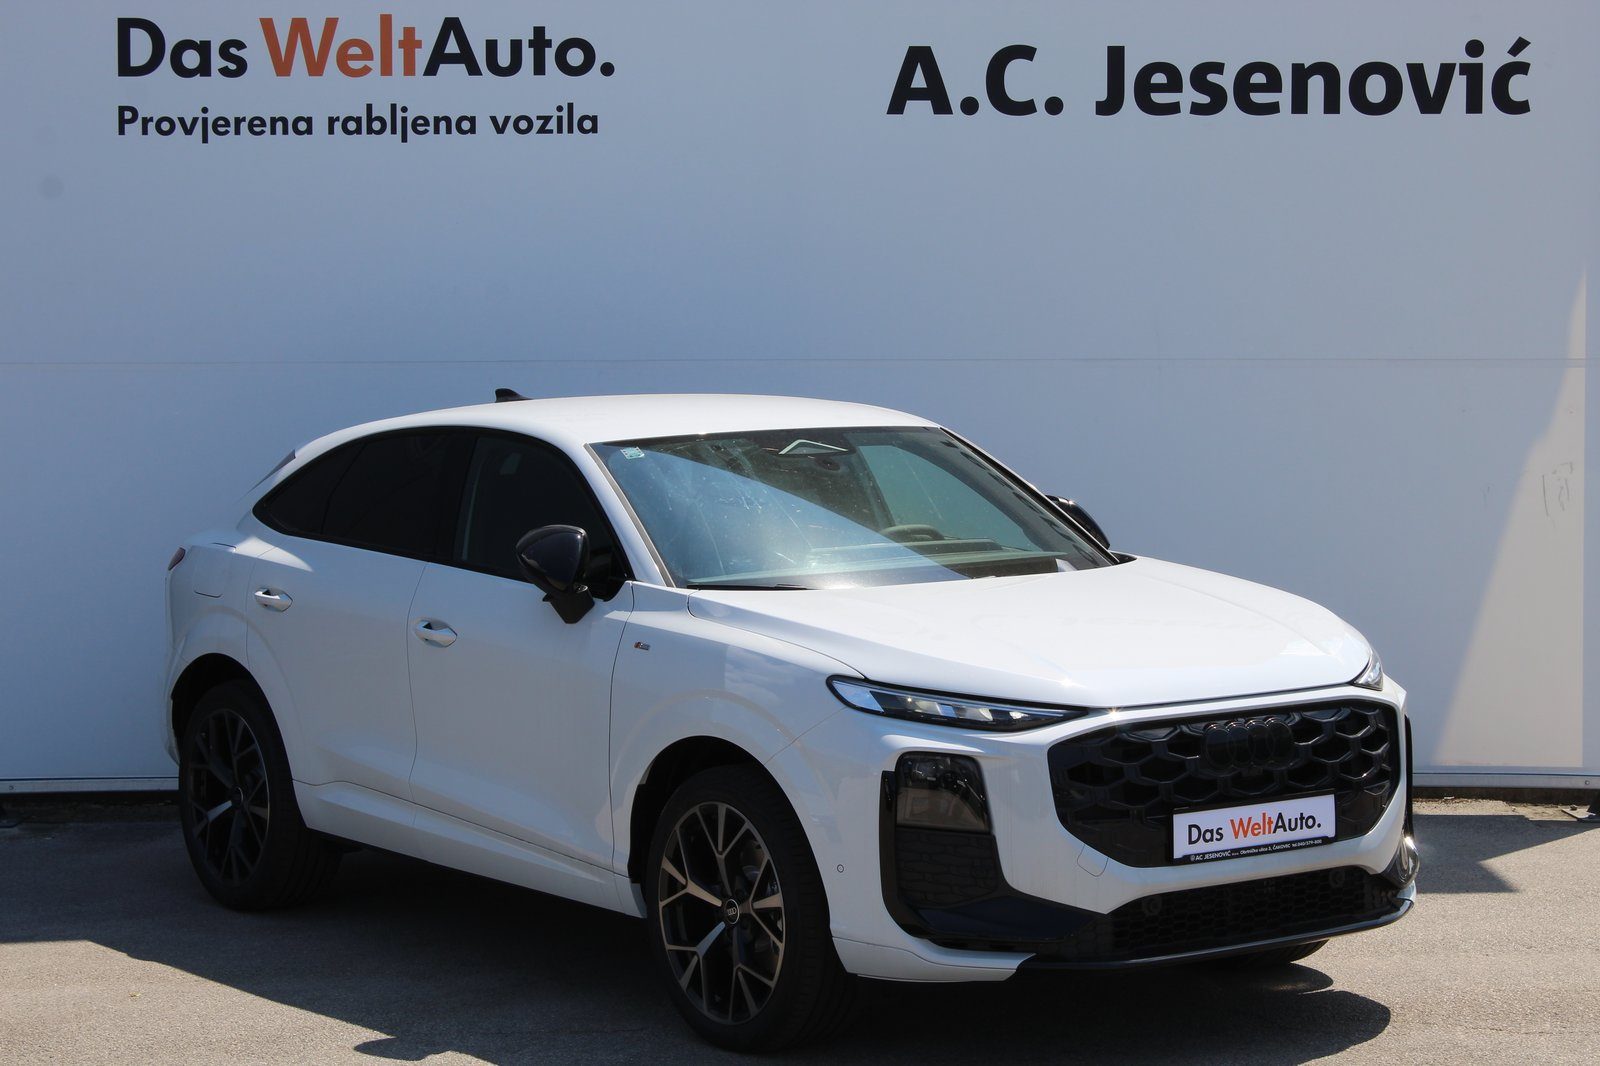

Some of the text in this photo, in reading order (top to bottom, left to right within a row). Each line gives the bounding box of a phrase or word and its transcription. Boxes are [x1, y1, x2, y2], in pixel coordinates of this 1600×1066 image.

[118, 14, 615, 78] Das WeltAuto.
[886, 37, 1532, 117] A.C. Jesenović
[117, 103, 599, 144] Provjerena rabljena vozila
[1187, 811, 1322, 846] Das WeltAuto.
[1204, 850, 1232, 860] JESENOVIĆ
